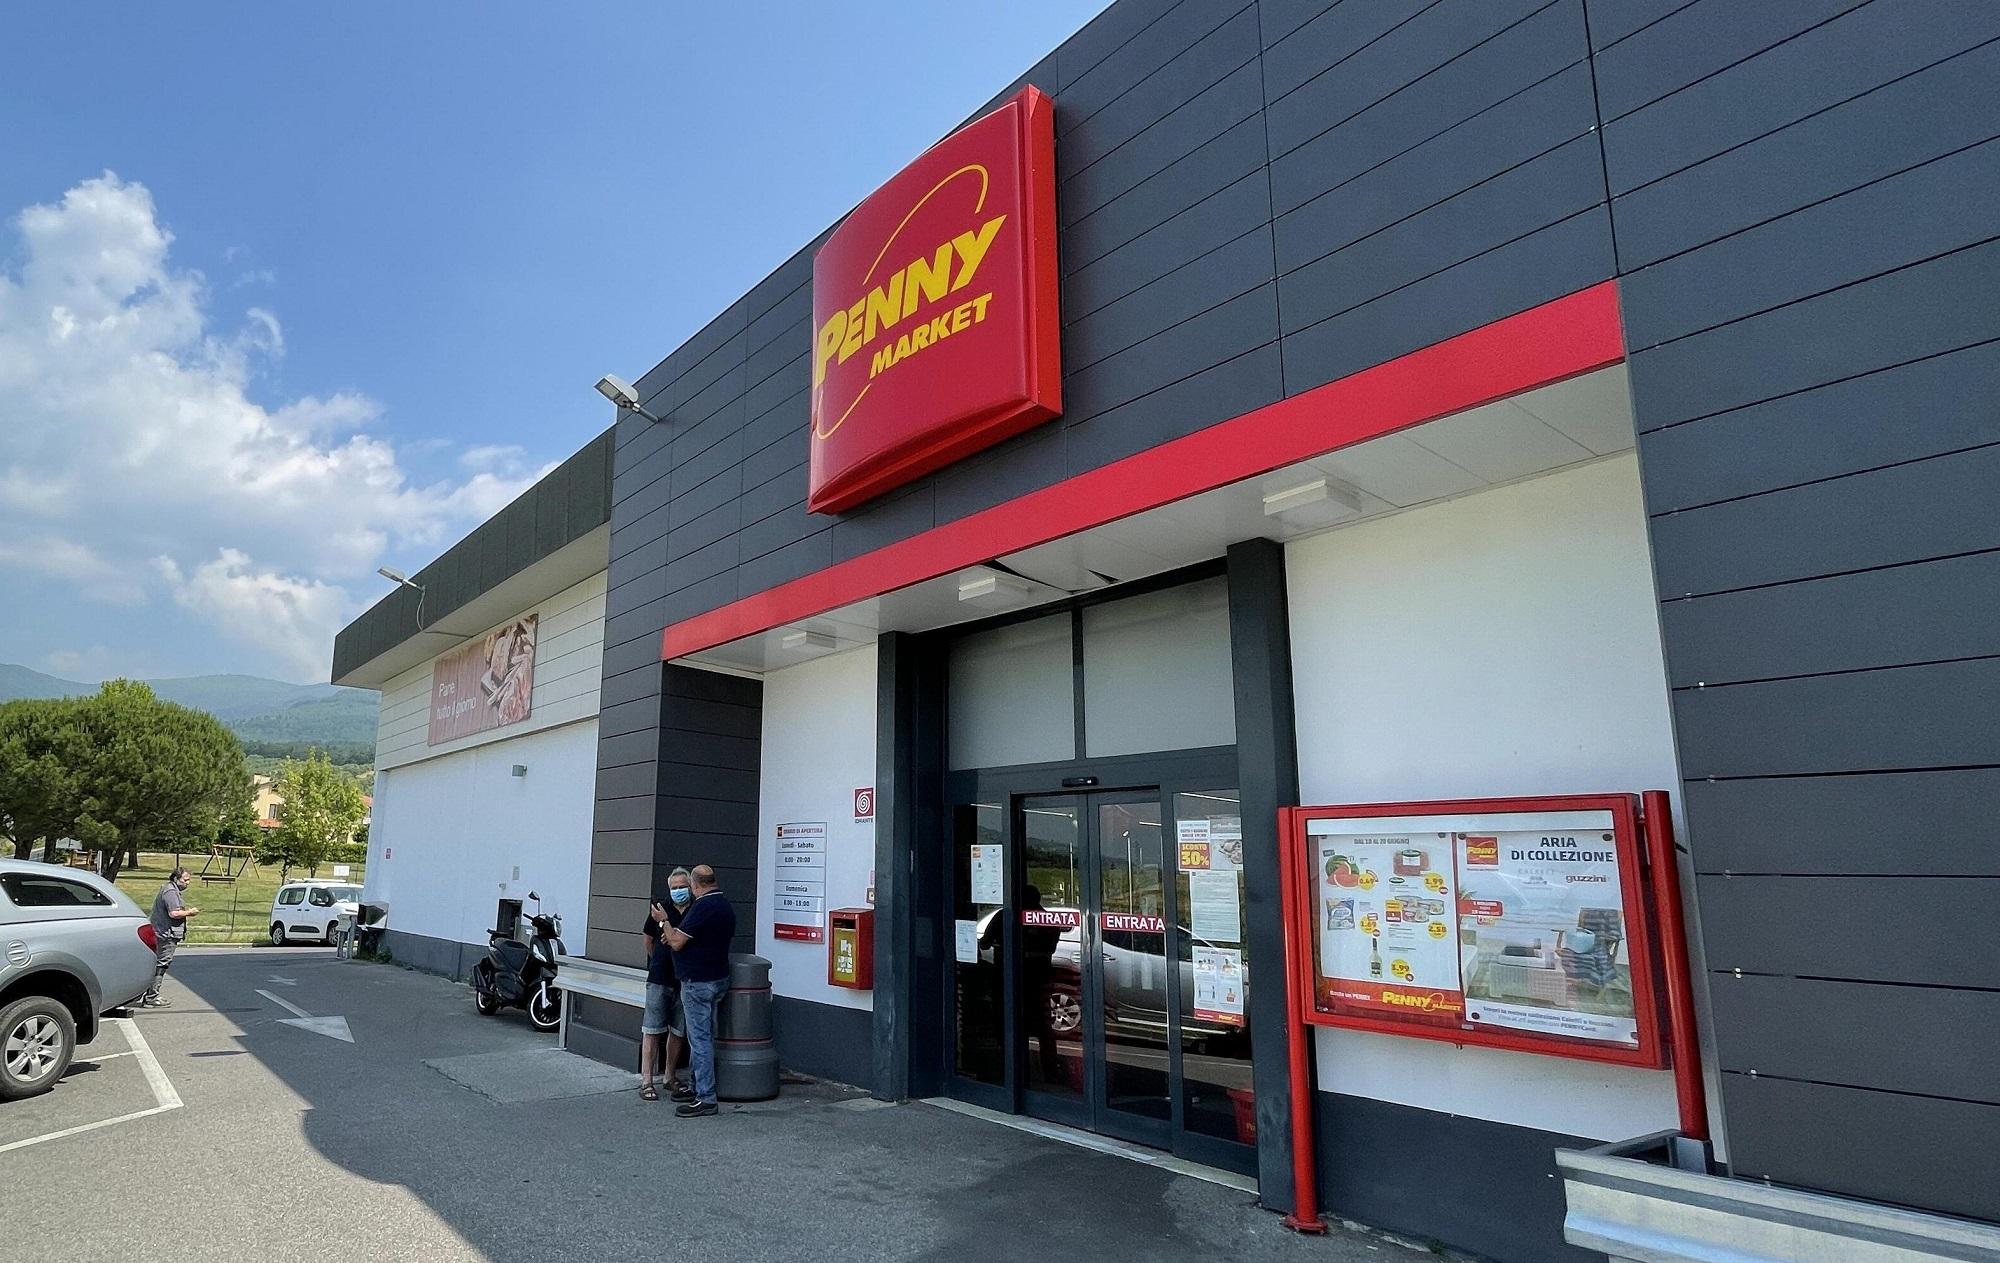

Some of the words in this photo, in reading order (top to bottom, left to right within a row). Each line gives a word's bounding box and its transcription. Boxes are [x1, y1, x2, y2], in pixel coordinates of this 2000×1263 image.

[815, 215, 1007, 389] PENNY
[870, 292, 992, 379] MARKET
[439, 682, 455, 697] Pane
[1540, 837, 1577, 848] ARIA
[1181, 850, 1209, 866] 30%
[1511, 850, 1525, 860] DI
[1527, 850, 1614, 862] COLLEZIONE
[1565, 874, 1607, 883] guzzini
[1025, 911, 1077, 925] ENTRATA
[1106, 916, 1166, 931] ENTRATA
[1382, 991, 1432, 1008] PENNY
